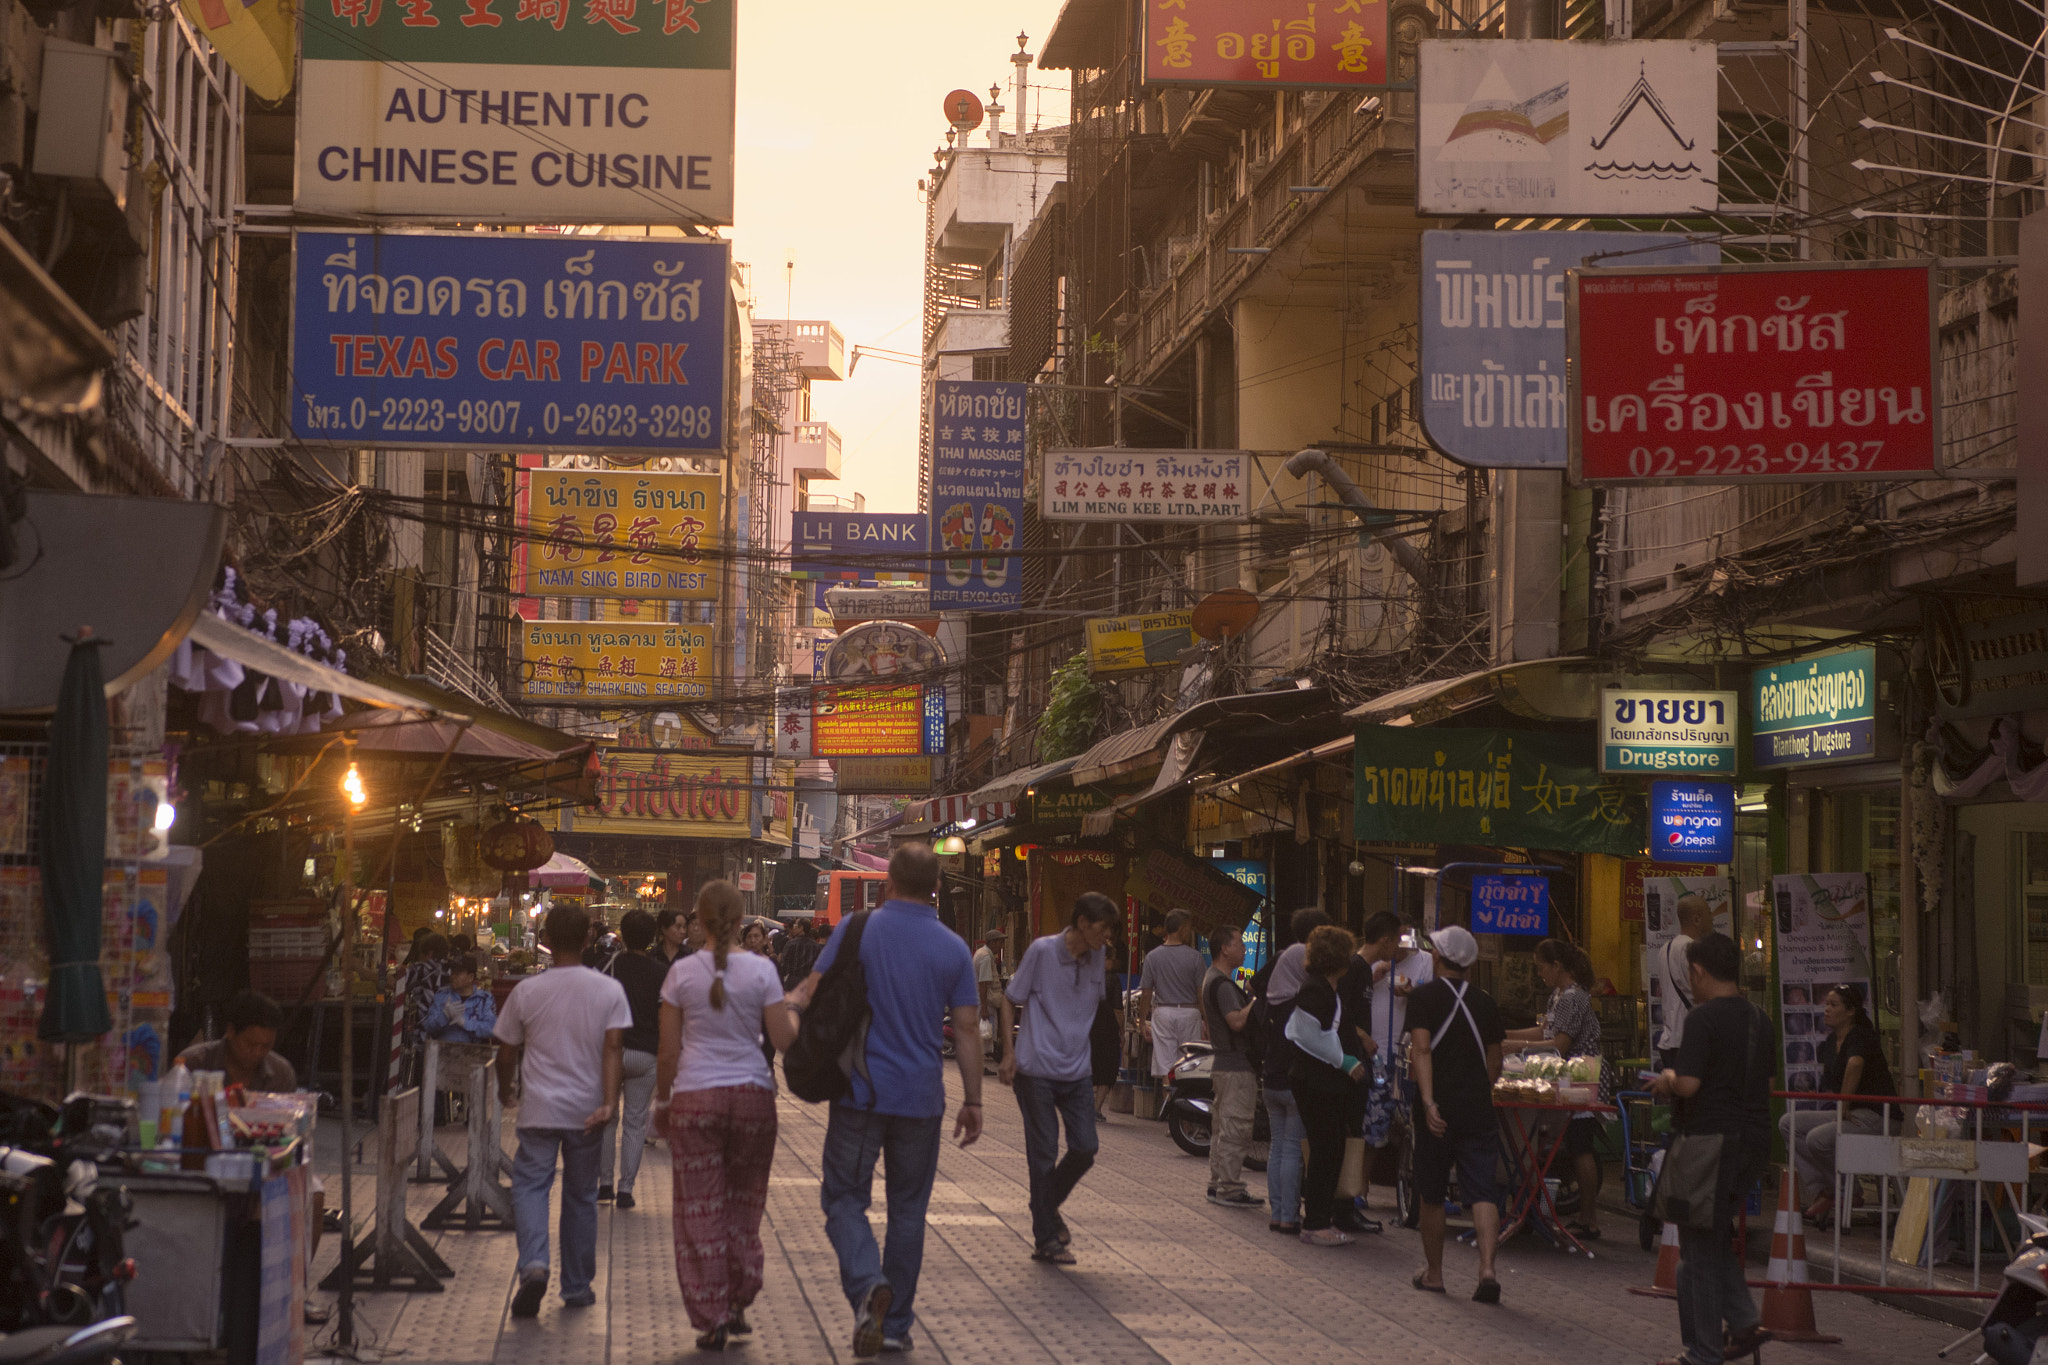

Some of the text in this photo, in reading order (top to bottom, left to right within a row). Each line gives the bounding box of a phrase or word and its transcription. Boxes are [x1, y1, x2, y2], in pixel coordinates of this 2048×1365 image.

[1156, 0, 1200, 68] 意
[1216, 3, 1316, 78] อยู่อี่
[385, 88, 649, 129] AUTHENTIC
[318, 146, 712, 190] CHINESE CUISINE
[323, 238, 702, 322] ที่จอดรถ เท็กซัส
[1655, 293, 1848, 355] เท็กซัส
[330, 334, 689, 385] TEXAS CAR PARK
[939, 385, 1021, 420] หัตถชัย
[1586, 363, 1926, 433] เครื่องเขียน
[543, 402, 712, 438] 0-2623-3298
[940, 426, 1022, 443] 古式按摩
[939, 447, 1022, 462] THAI MASSAGE
[1629, 440, 1885, 477] 02-223-9437
[1054, 456, 1144, 477] ห้างใบชา
[633, 480, 706, 510] รังนก
[937, 482, 1021, 499] นวดแผนไทย
[1052, 501, 1079, 513] LIM
[1085, 502, 1127, 514] MENG
[1133, 503, 1161, 515] KEE
[803, 522, 916, 542] LH BANK
[539, 569, 707, 589] NAM SING BIRD NEST
[934, 590, 1017, 604] REFLEXOLOGY
[1143, 614, 1191, 629] ตราช้าง
[530, 627, 581, 646] รังนก
[587, 631, 656, 653] หูฉลาม
[598, 655, 638, 678] 魚翅
[660, 656, 698, 680] 海鮮
[529, 681, 705, 697] BIRD NEST SHARK FINS SEA FOOD
[1760, 664, 1866, 723] คลังยาเหรียญทอง
[1615, 698, 1726, 726] ขายยา
[1610, 727, 1730, 743] โดยเภสัชกรปริญญา
[1773, 731, 1852, 758] Rianthong Drugstore
[1618, 748, 1720, 770] Drugstore
[1057, 793, 1093, 806] ATM
[1671, 789, 1714, 802] ร้านเด็ด
[1685, 835, 1716, 847] pepsi
[1779, 945, 1816, 954] Shampoo
[1787, 933, 1858, 944] Deep-sea Mineral
